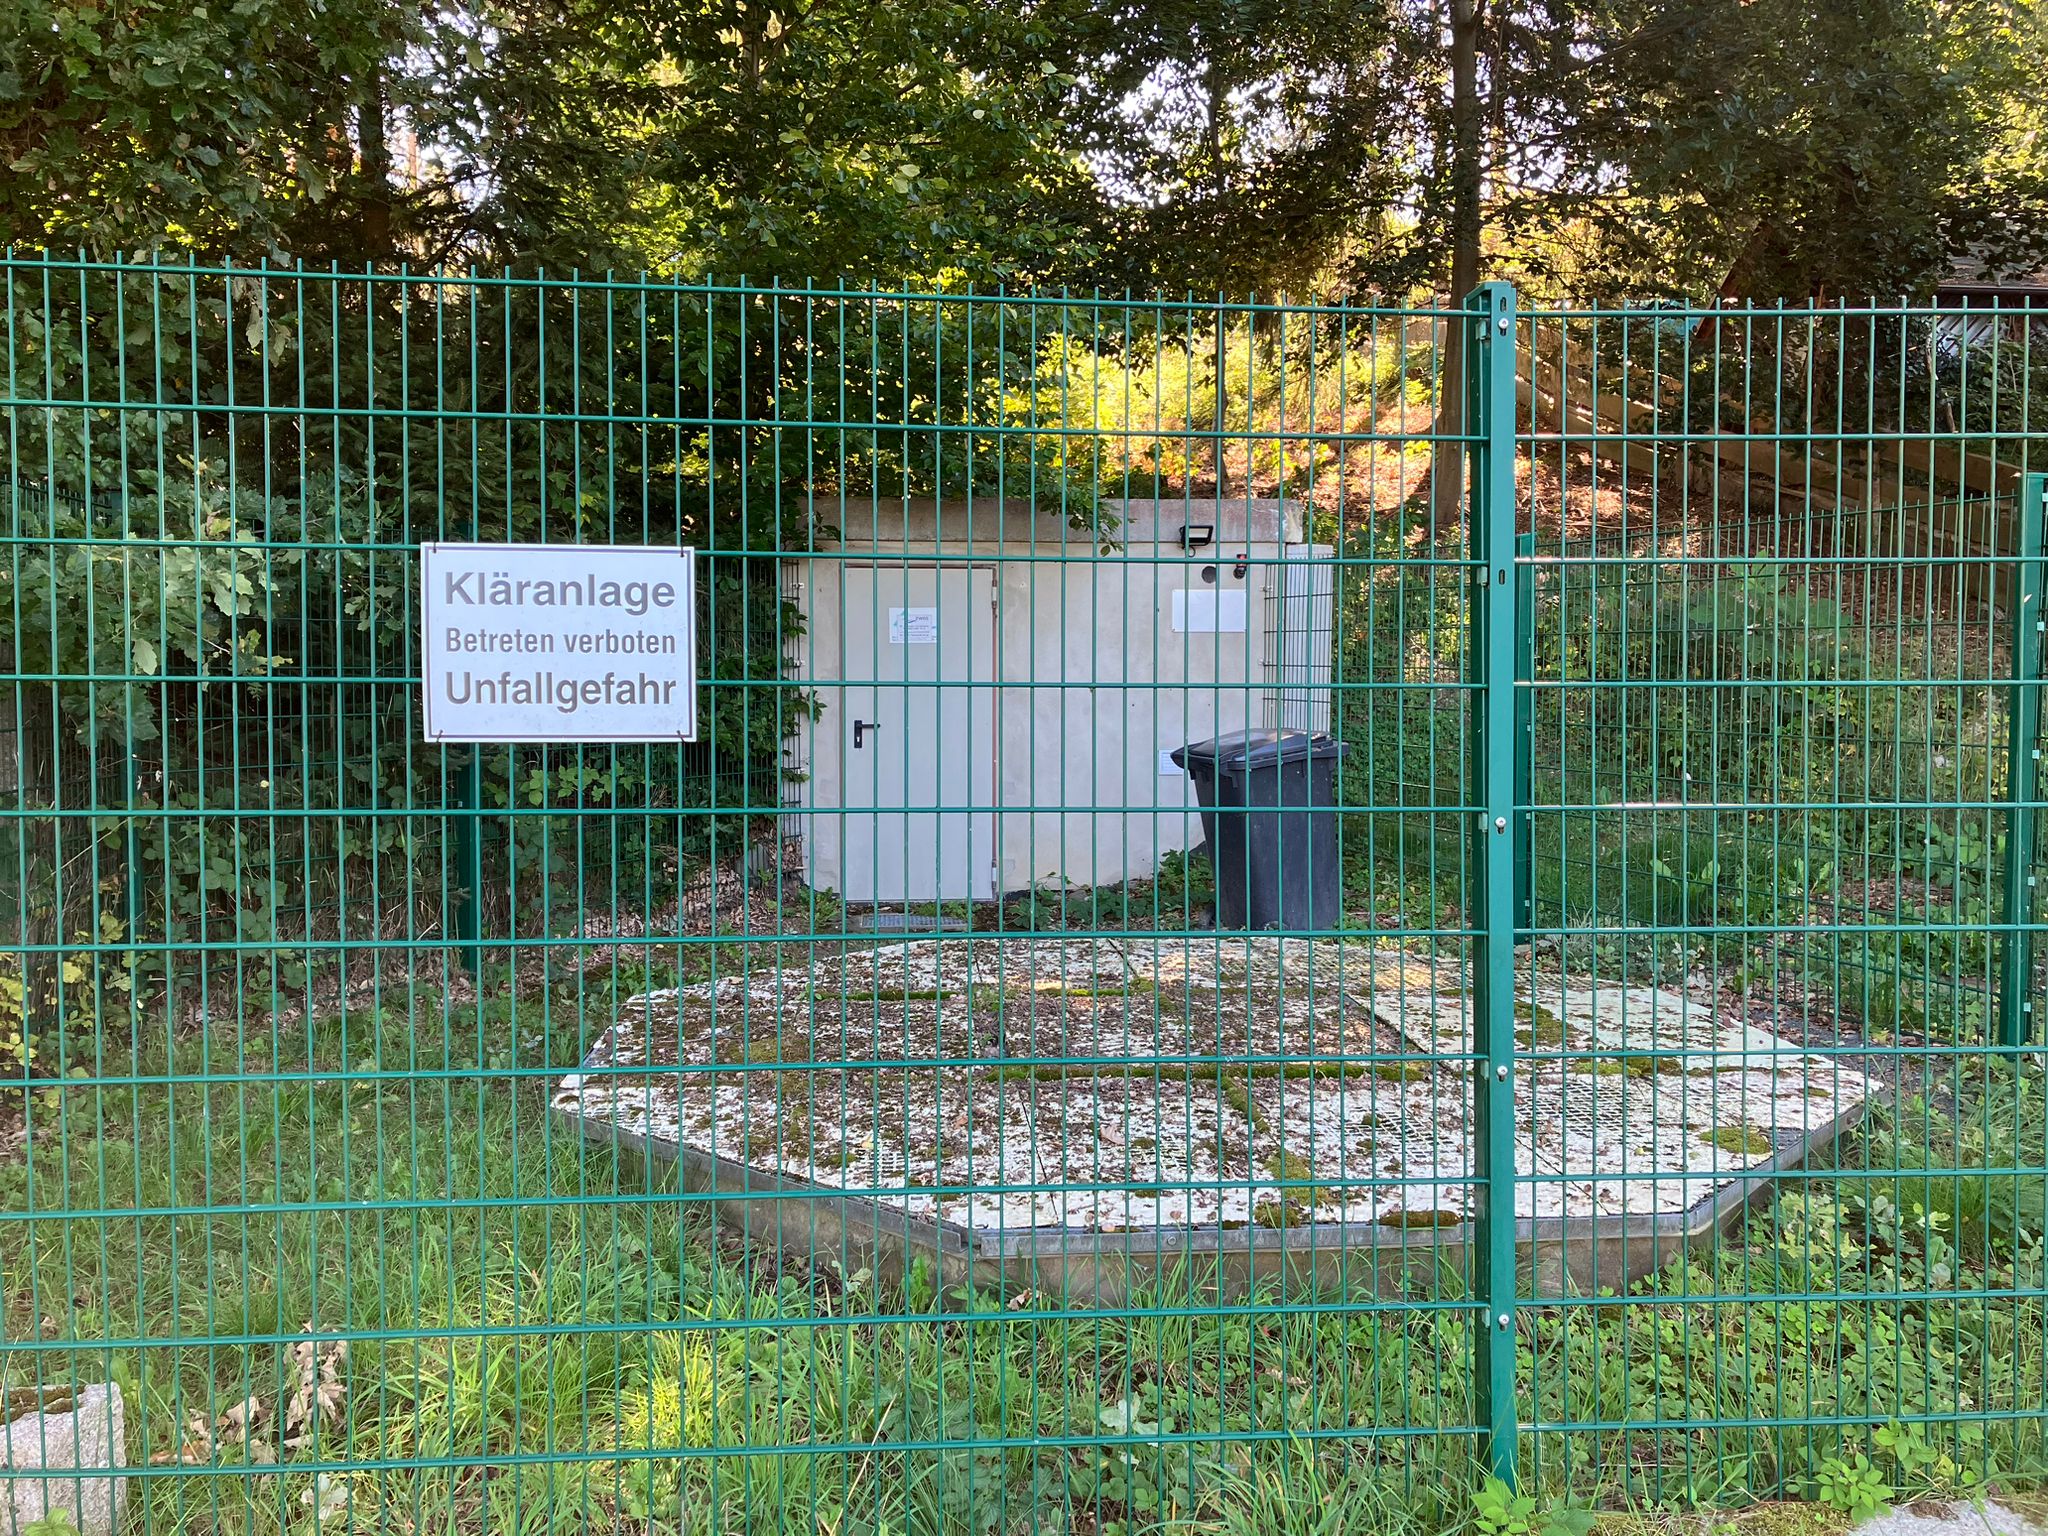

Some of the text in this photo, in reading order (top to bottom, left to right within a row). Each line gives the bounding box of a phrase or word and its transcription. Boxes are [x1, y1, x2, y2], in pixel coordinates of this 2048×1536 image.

[446, 571, 675, 615] Kläranlage
[446, 627, 675, 654] Betreten verboten
[446, 671, 676, 713] Unfallgefahr
